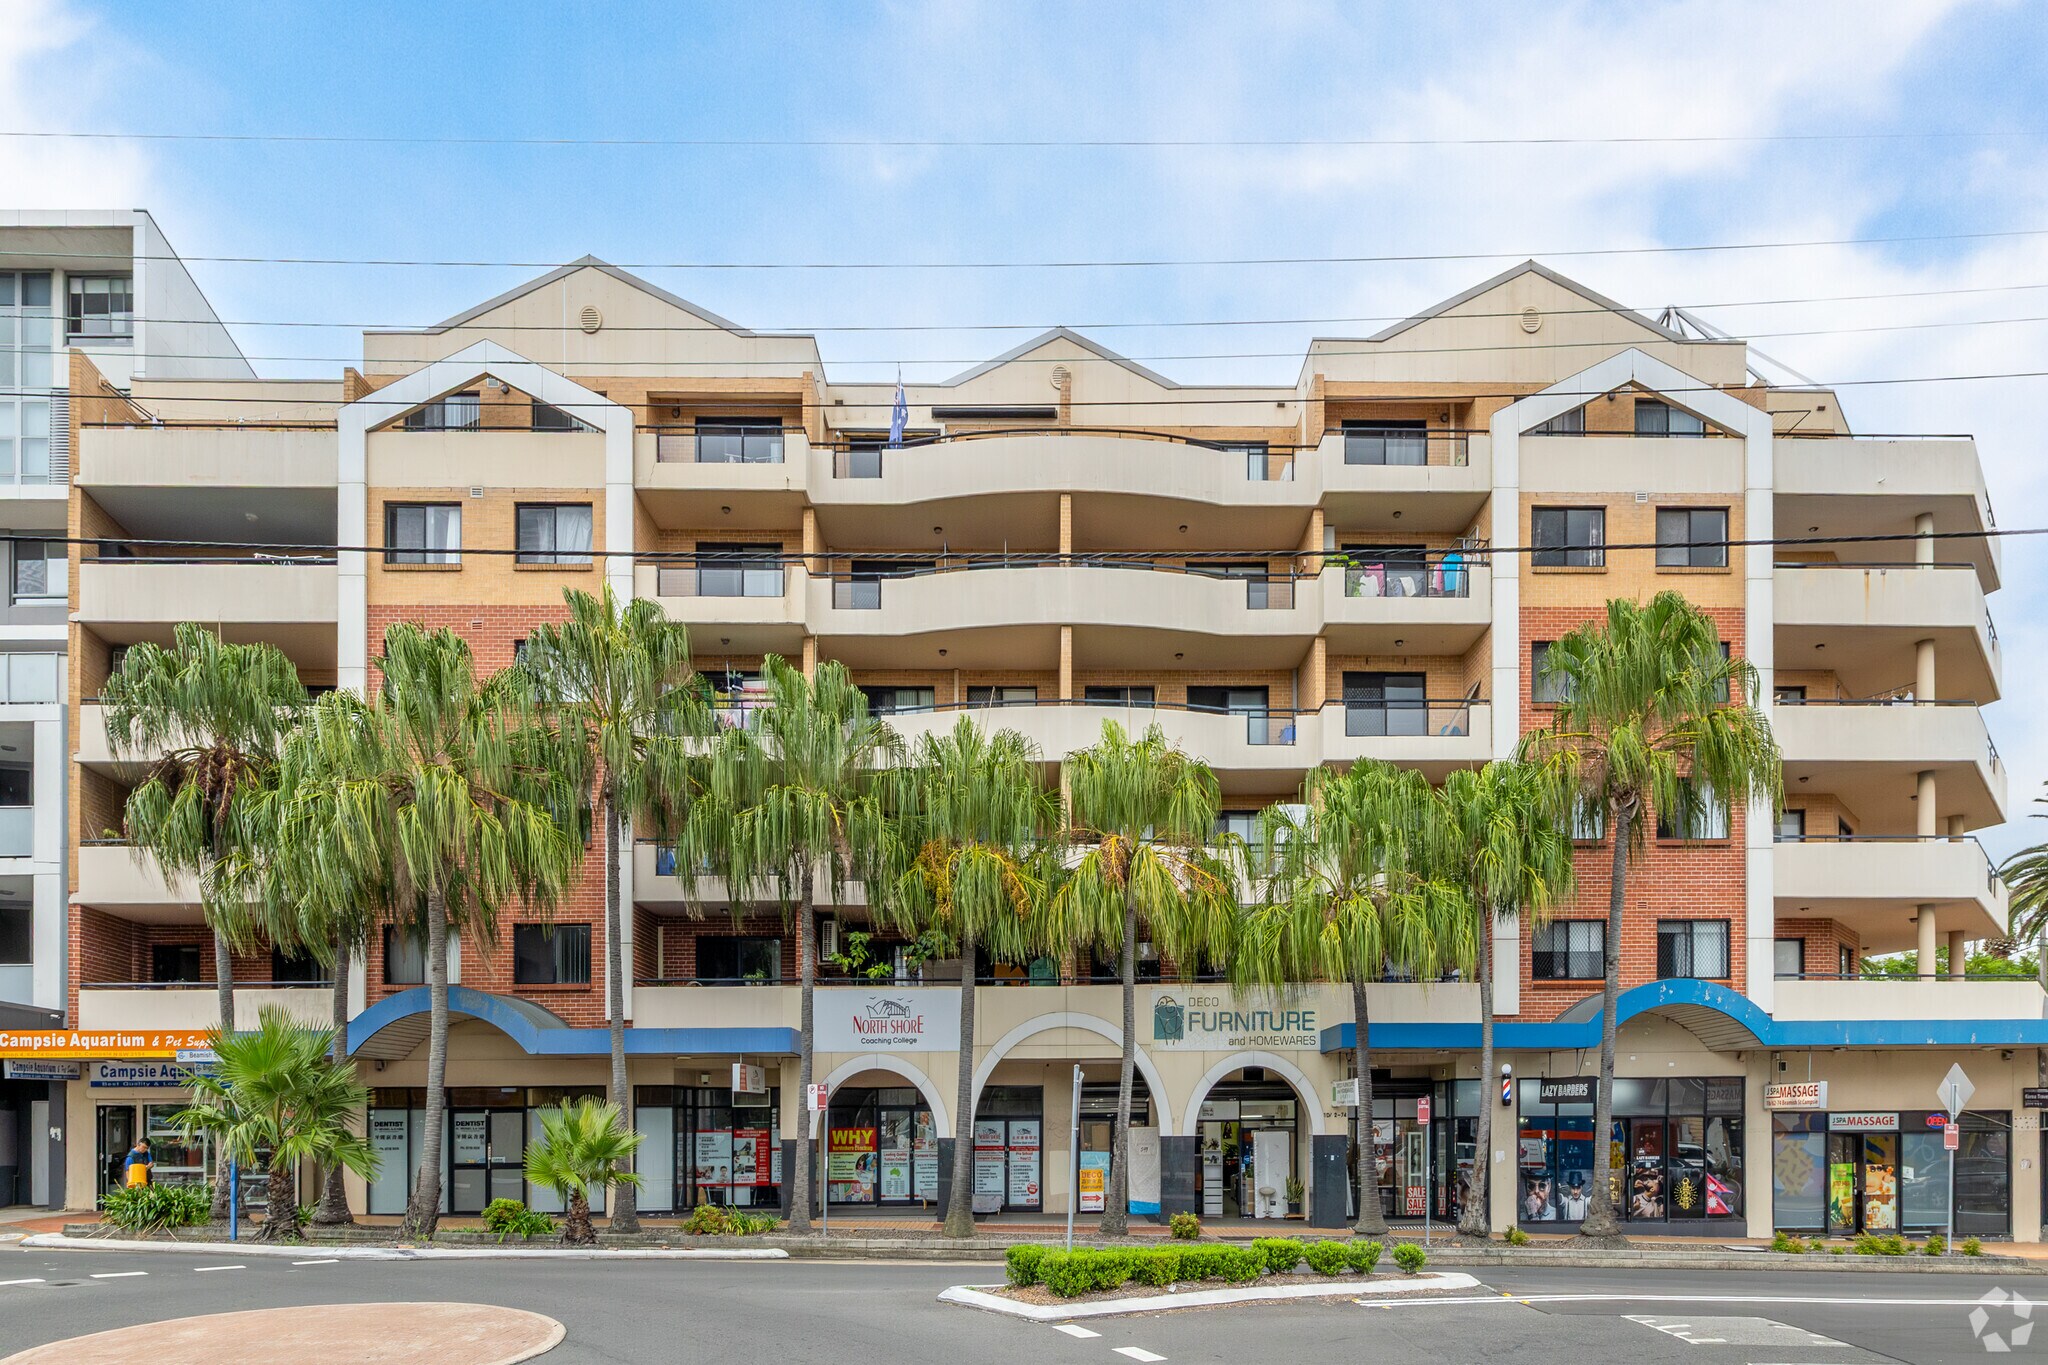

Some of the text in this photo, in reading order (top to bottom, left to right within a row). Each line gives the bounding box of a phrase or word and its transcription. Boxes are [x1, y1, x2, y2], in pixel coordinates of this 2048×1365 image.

[1188, 996, 1219, 1008] DECO
[853, 1014, 925, 1035] NORTH SHORE
[1188, 1011, 1316, 1033] FURNITURE
[0, 1032, 66, 1051] Campsie
[70, 1032, 145, 1051] Aquarium
[152, 1036, 160, 1047] &
[165, 1035, 182, 1047] Pet
[860, 1036, 918, 1046] Coaching College
[1228, 1035, 1317, 1047] and HOMEWARES
[189, 1051, 213, 1059] Beamish
[12, 1061, 33, 1073] Campsie
[100, 1064, 157, 1080] Campsie
[1541, 1083, 1589, 1097] LAZY BARBERS
[1770, 1087, 1780, 1096] SPA
[1780, 1085, 1819, 1098] MASSAGE
[1847, 1115, 1895, 1126] MASSAGE
[1926, 1116, 1948, 1127] OPEN
[832, 1130, 873, 1145] WHY
[1408, 1187, 1426, 1198] SALE
[1408, 1199, 1426, 1209] SALE
